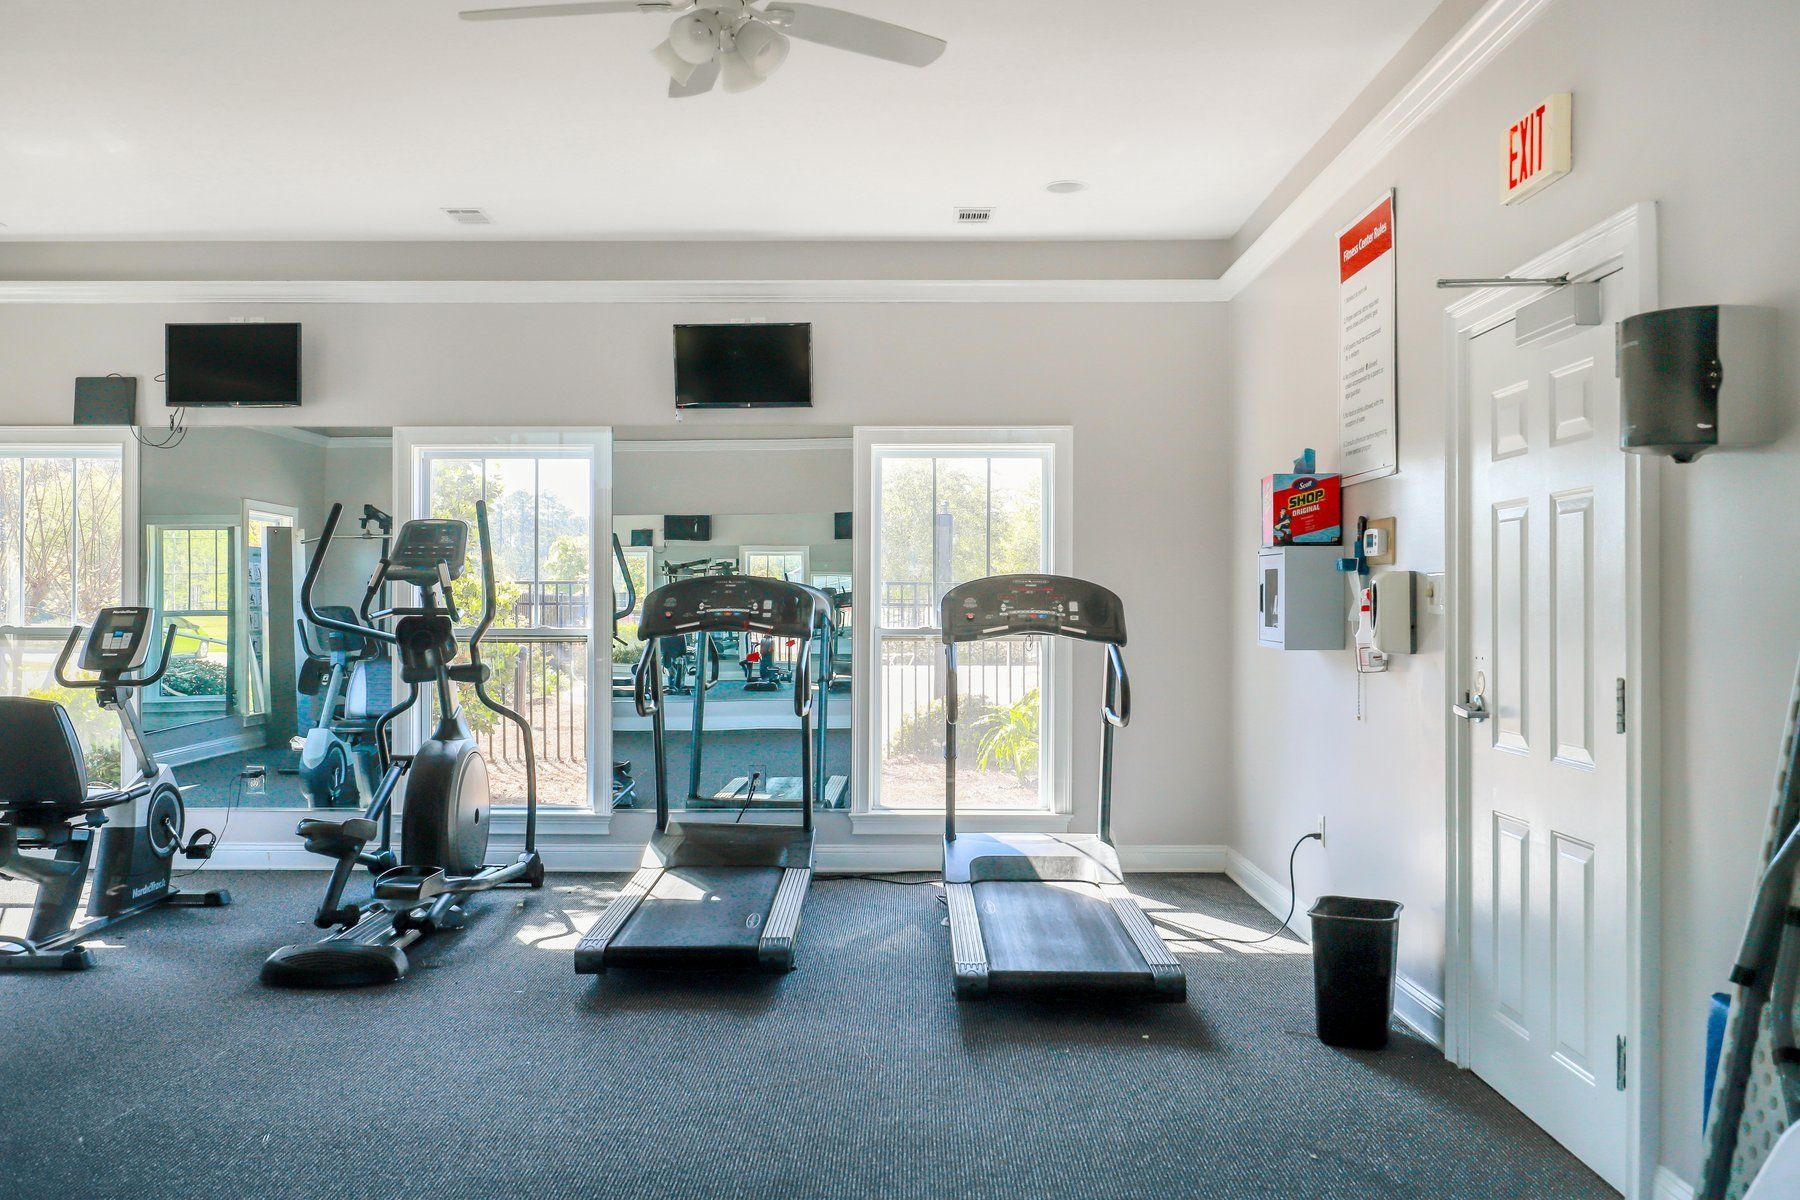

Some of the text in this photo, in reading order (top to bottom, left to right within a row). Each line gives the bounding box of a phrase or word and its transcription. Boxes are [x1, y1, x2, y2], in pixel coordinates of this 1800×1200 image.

[1509, 104, 1546, 190] EXIT
[1343, 222, 1387, 263] Fitness Center Rules
[1288, 488, 1325, 510] SHOP
[1292, 503, 1320, 517] ORIGINAL
